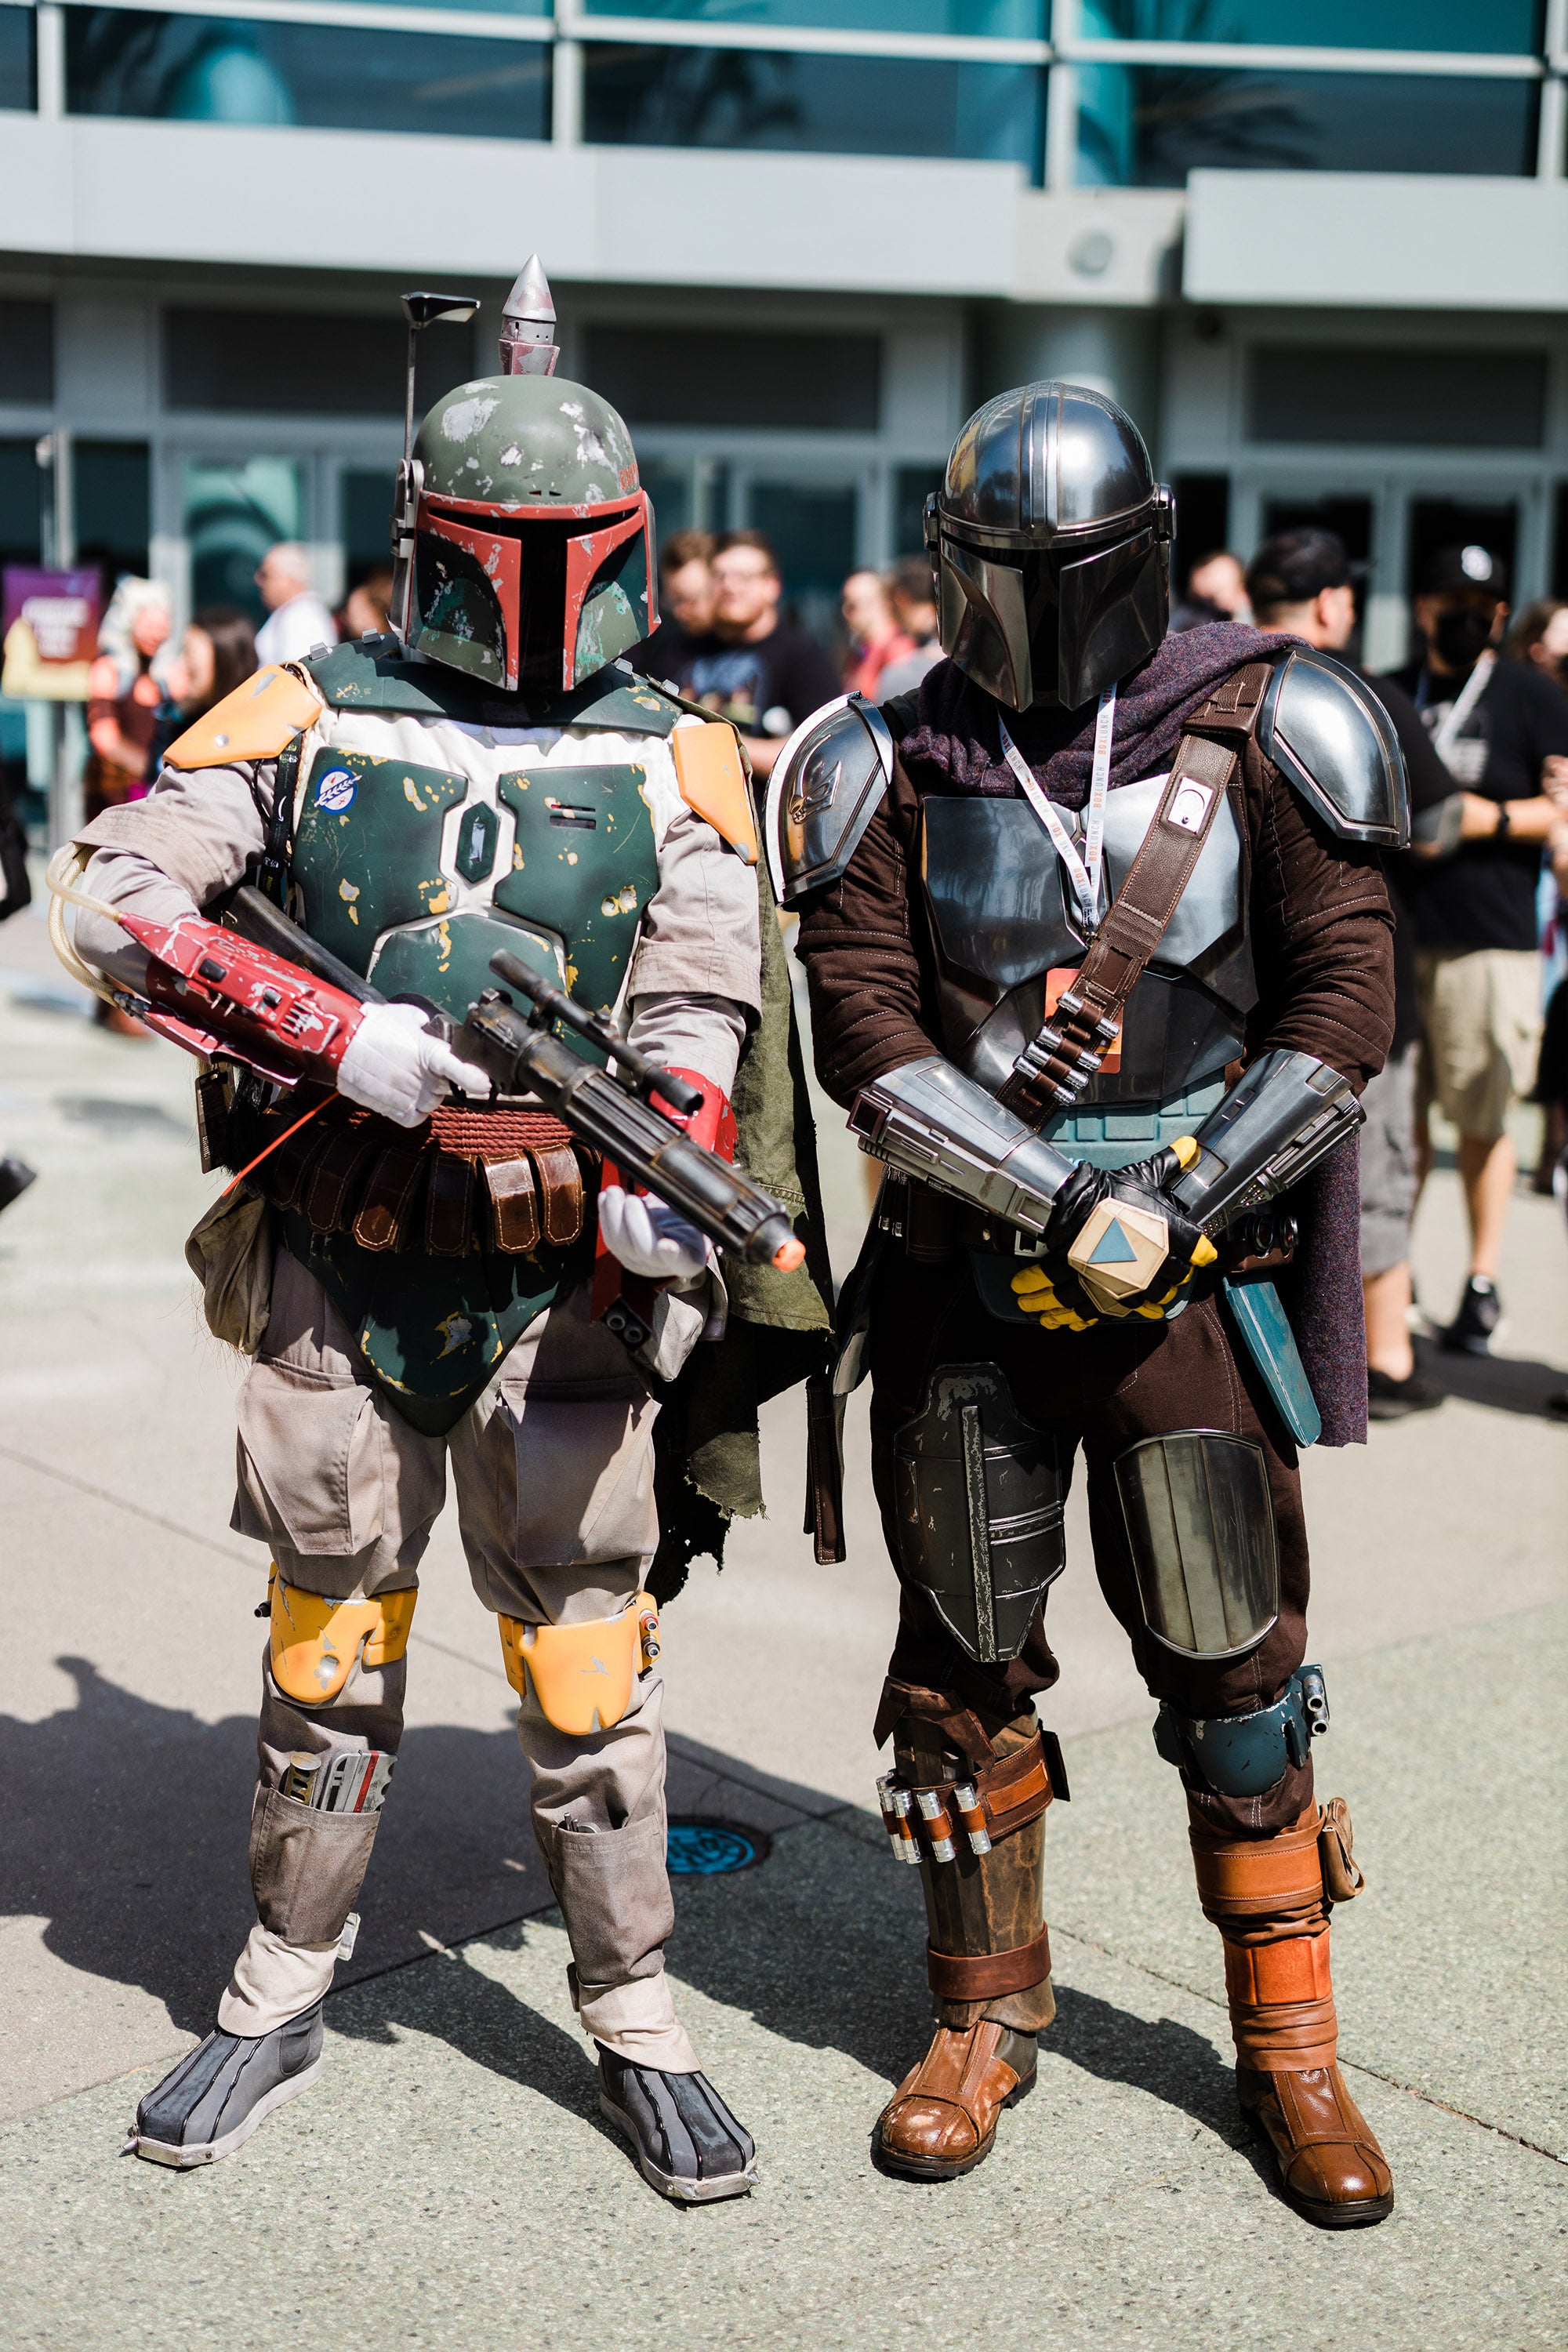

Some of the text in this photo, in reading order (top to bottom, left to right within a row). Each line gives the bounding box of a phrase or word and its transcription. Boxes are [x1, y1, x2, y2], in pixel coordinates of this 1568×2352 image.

[1002, 734, 1024, 771] BOXUNCH
[1098, 714, 1109, 755] BOXLUNCH
[1093, 767, 1105, 808] BOXLUNCH
[1051, 822, 1075, 858] BOXUNCH
[1088, 820, 1100, 861] BOXLUNCH
[1073, 867, 1093, 909] BOXLUNCH
